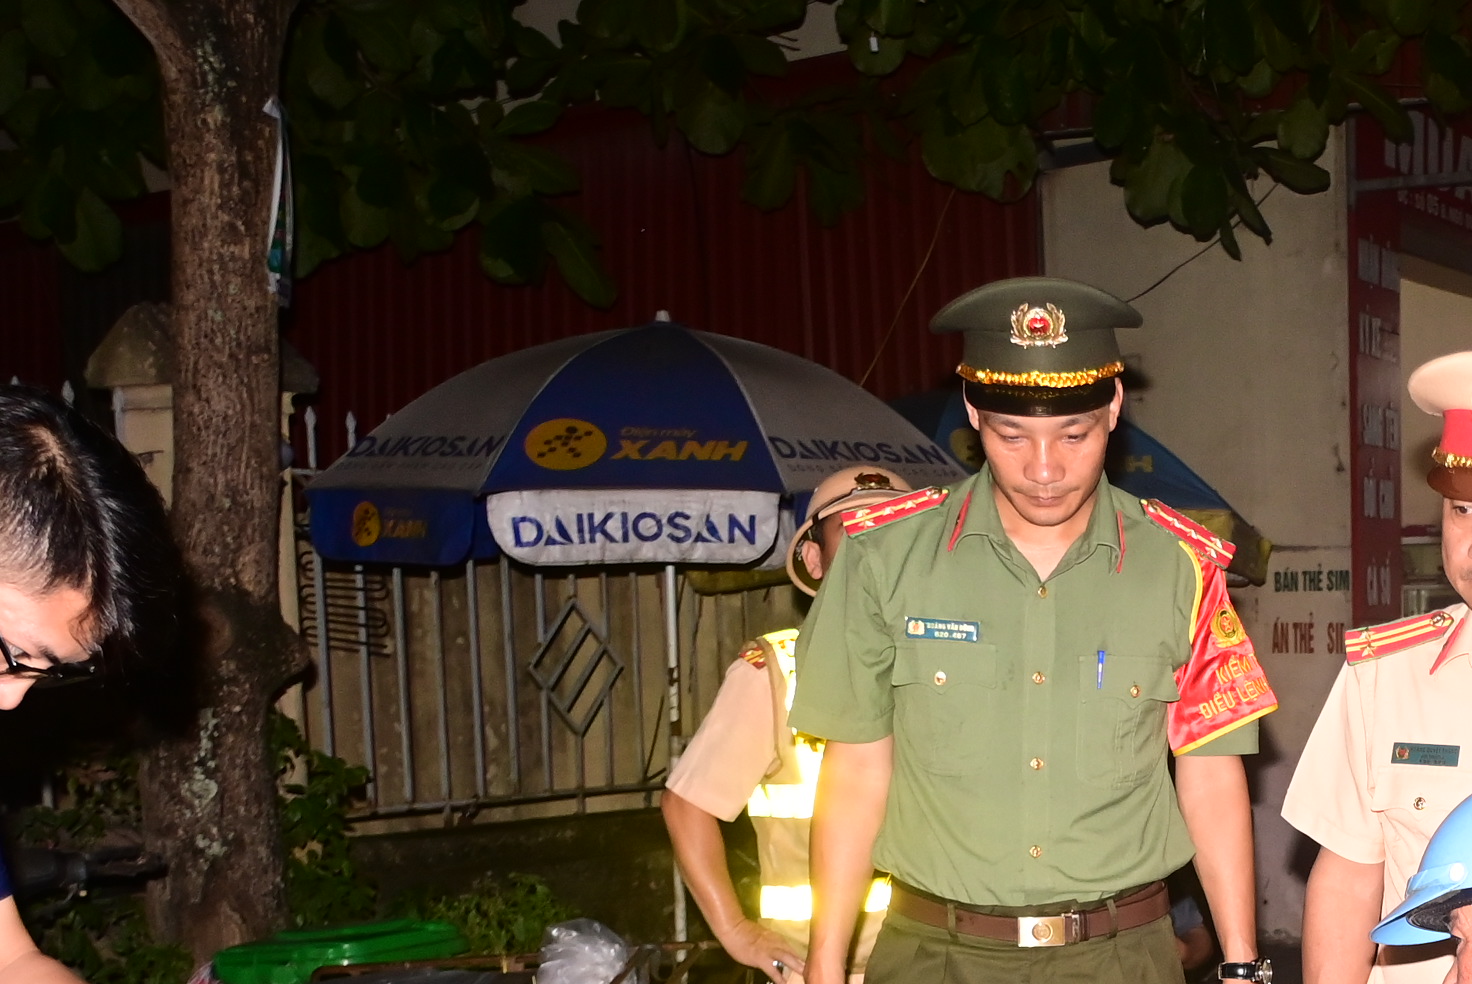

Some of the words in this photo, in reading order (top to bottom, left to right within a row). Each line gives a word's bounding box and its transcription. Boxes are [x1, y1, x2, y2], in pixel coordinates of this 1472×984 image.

[346, 435, 505, 458] DAIKIOSAN
[610, 440, 749, 461] XANH
[768, 436, 948, 465] DAIKIOSAN
[512, 511, 757, 548] DAIKIOSAN
[1274, 567, 1298, 592] BÁN
[1302, 563, 1323, 592] THẺ
[1327, 570, 1350, 592] SIM
[1293, 611, 1315, 654] THẺ
